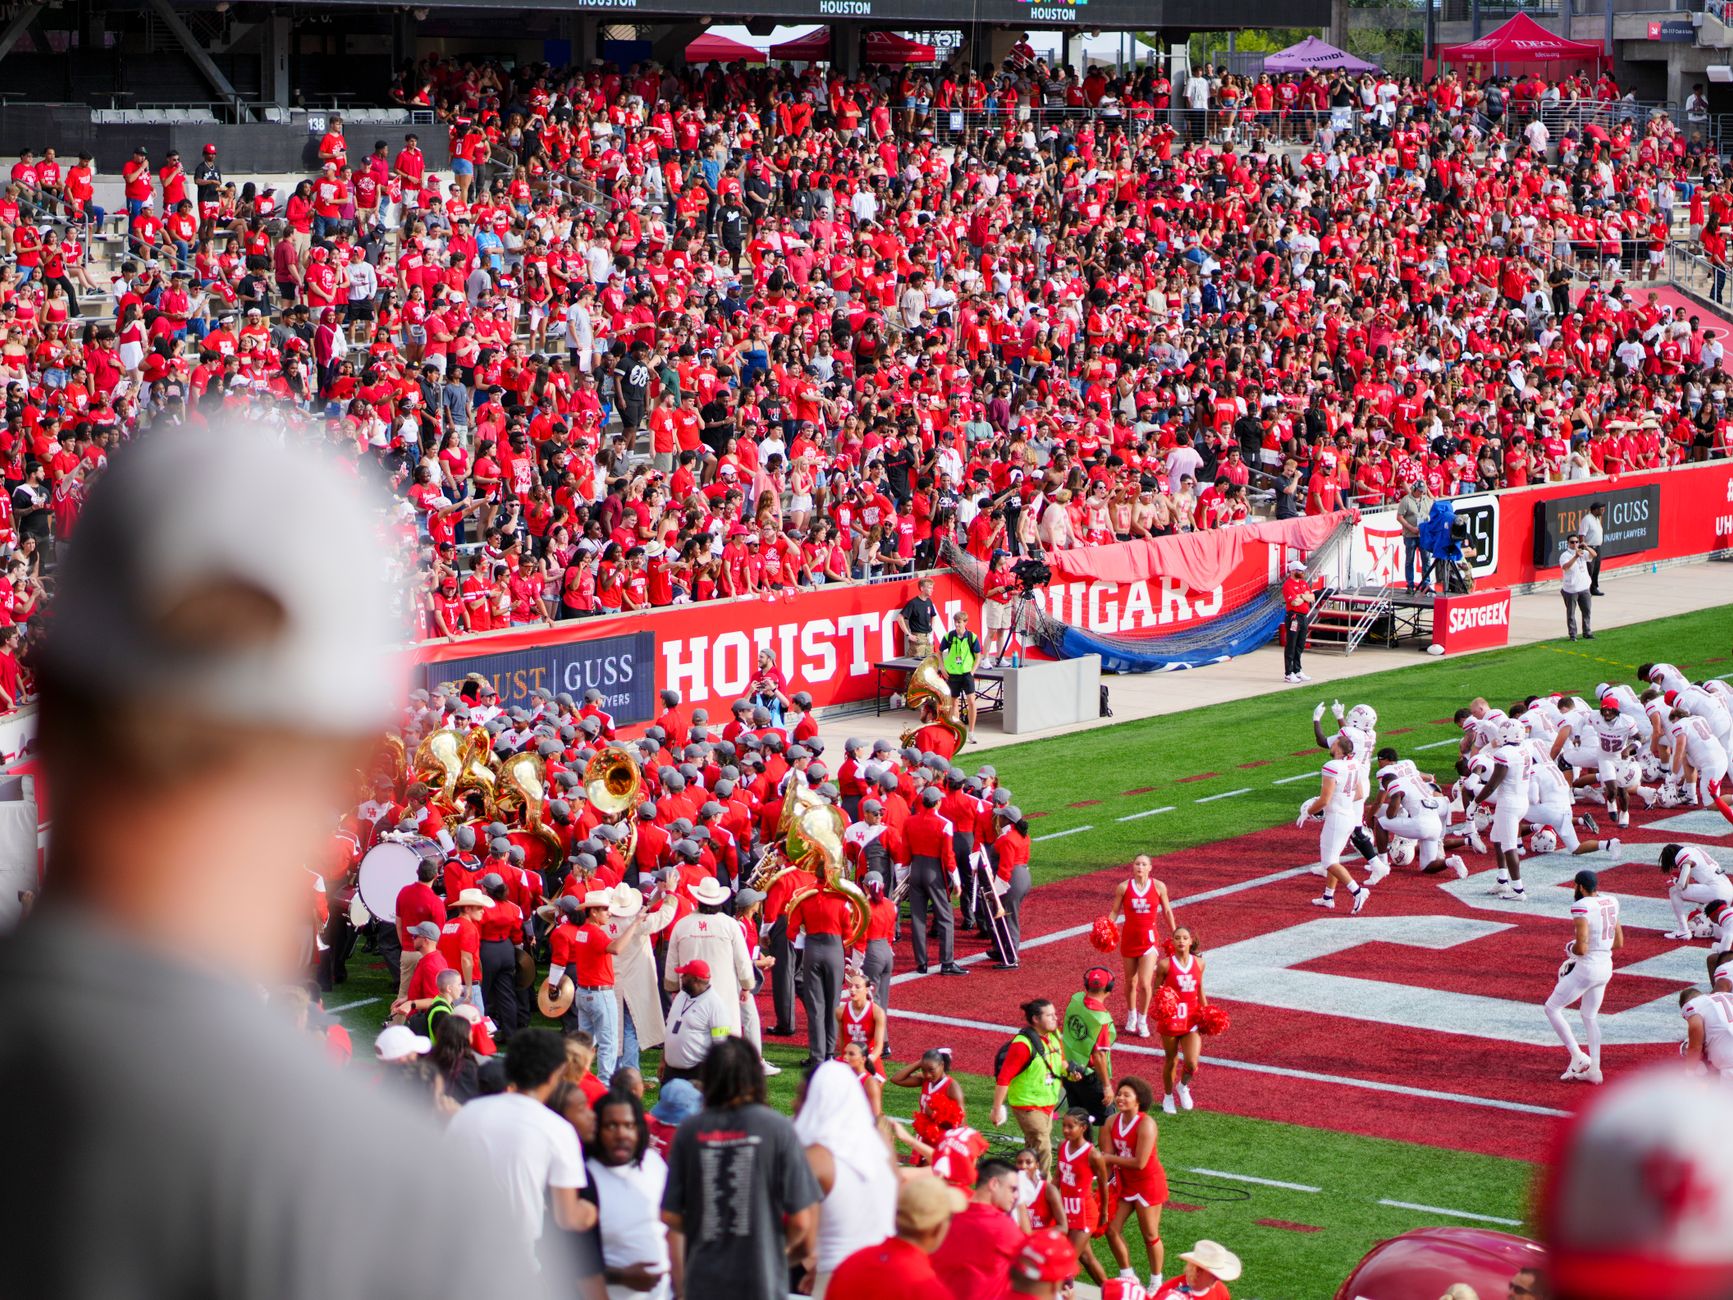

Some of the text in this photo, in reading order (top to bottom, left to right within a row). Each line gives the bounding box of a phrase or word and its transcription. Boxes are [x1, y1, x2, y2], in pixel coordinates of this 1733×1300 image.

[820, 1, 871, 14] HOUSTON
[1031, 7, 1076, 20] HOUSTON
[1511, 39, 1562, 48] TDECU
[308, 117, 325, 131] 138
[1613, 499, 1648, 525] GUSS
[1604, 531, 1622, 543] INJURY
[1624, 528, 1647, 539] LAWYERS
[1449, 599, 1509, 634] SEATGEEK
[564, 654, 633, 691] GUSS
[1600, 737, 1623, 752] 82
[1600, 905, 1617, 941] 15
